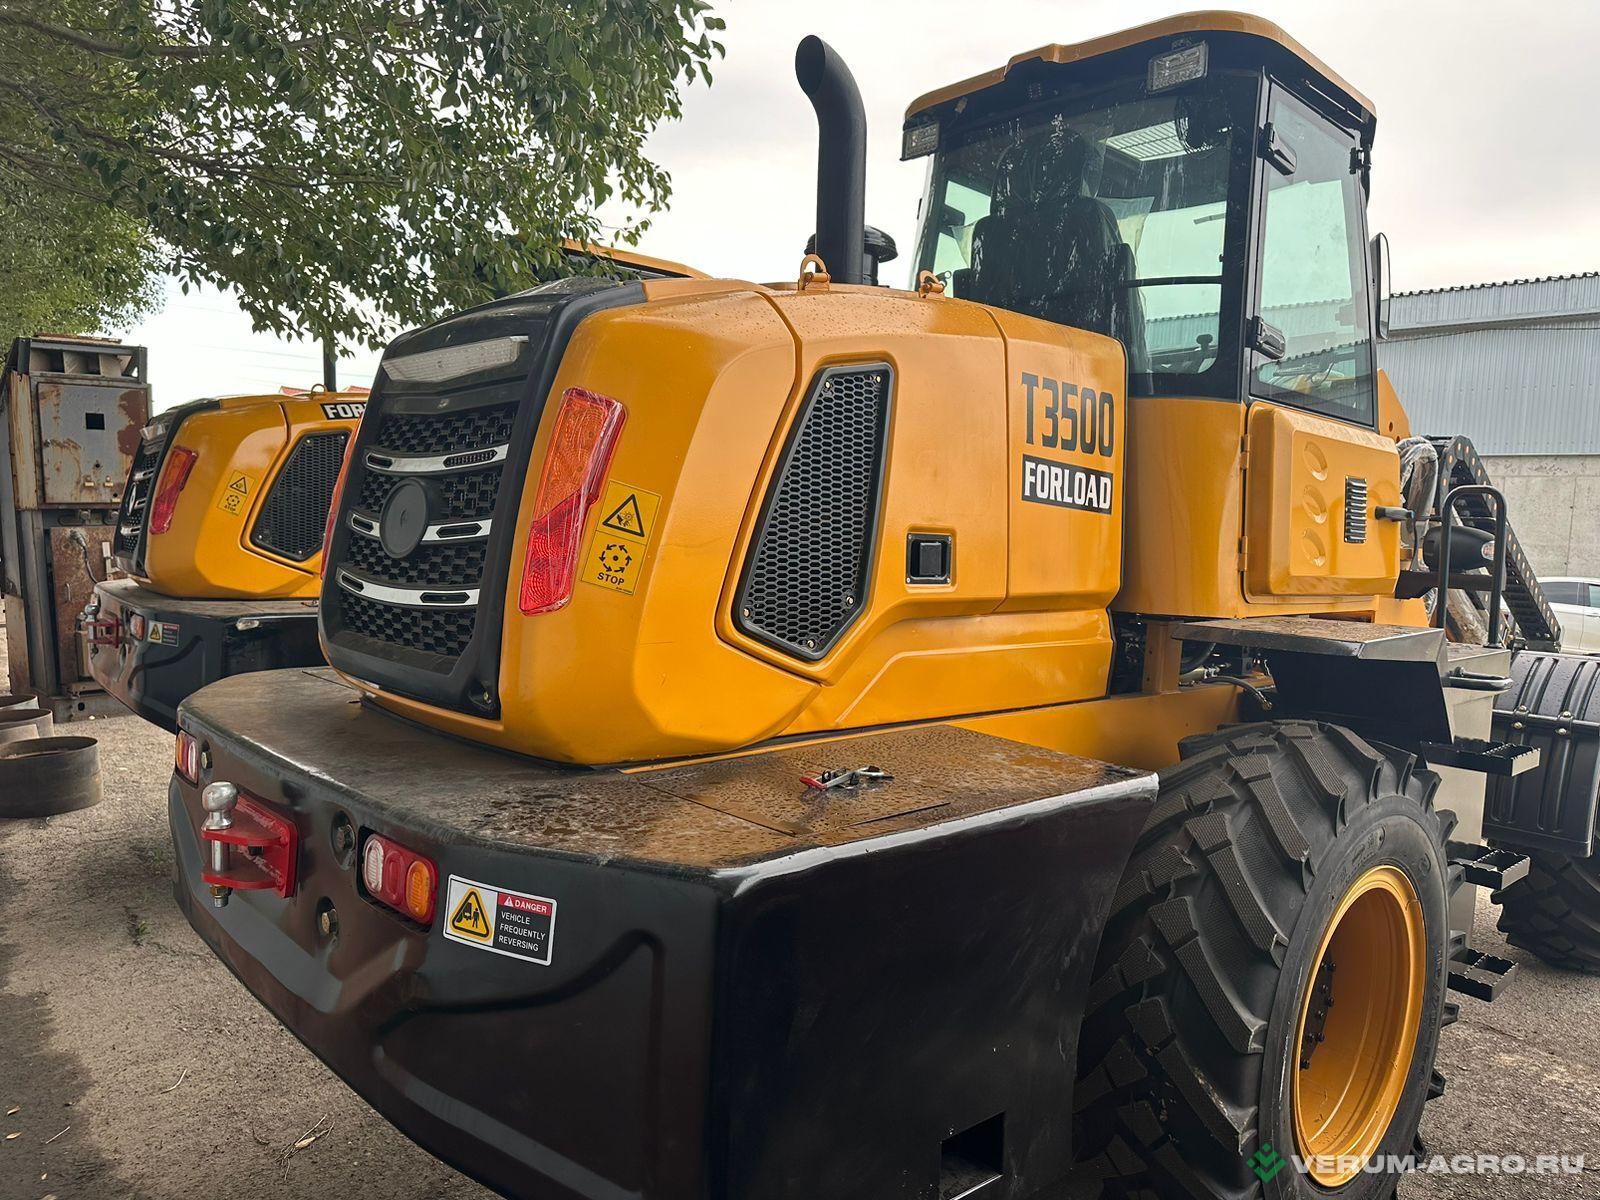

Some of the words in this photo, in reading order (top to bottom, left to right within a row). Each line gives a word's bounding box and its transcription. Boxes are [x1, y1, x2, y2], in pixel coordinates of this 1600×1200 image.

[323, 403, 367, 418] FOR
[1021, 371, 1114, 457] T3500
[1024, 460, 1112, 509] FORLOAD
[597, 572, 625, 585] STOP
[514, 899, 547, 913] DANGER
[501, 911, 531, 925] VEHICLE
[500, 923, 546, 940] FREQUENTLY
[498, 935, 539, 951] REVERSING
